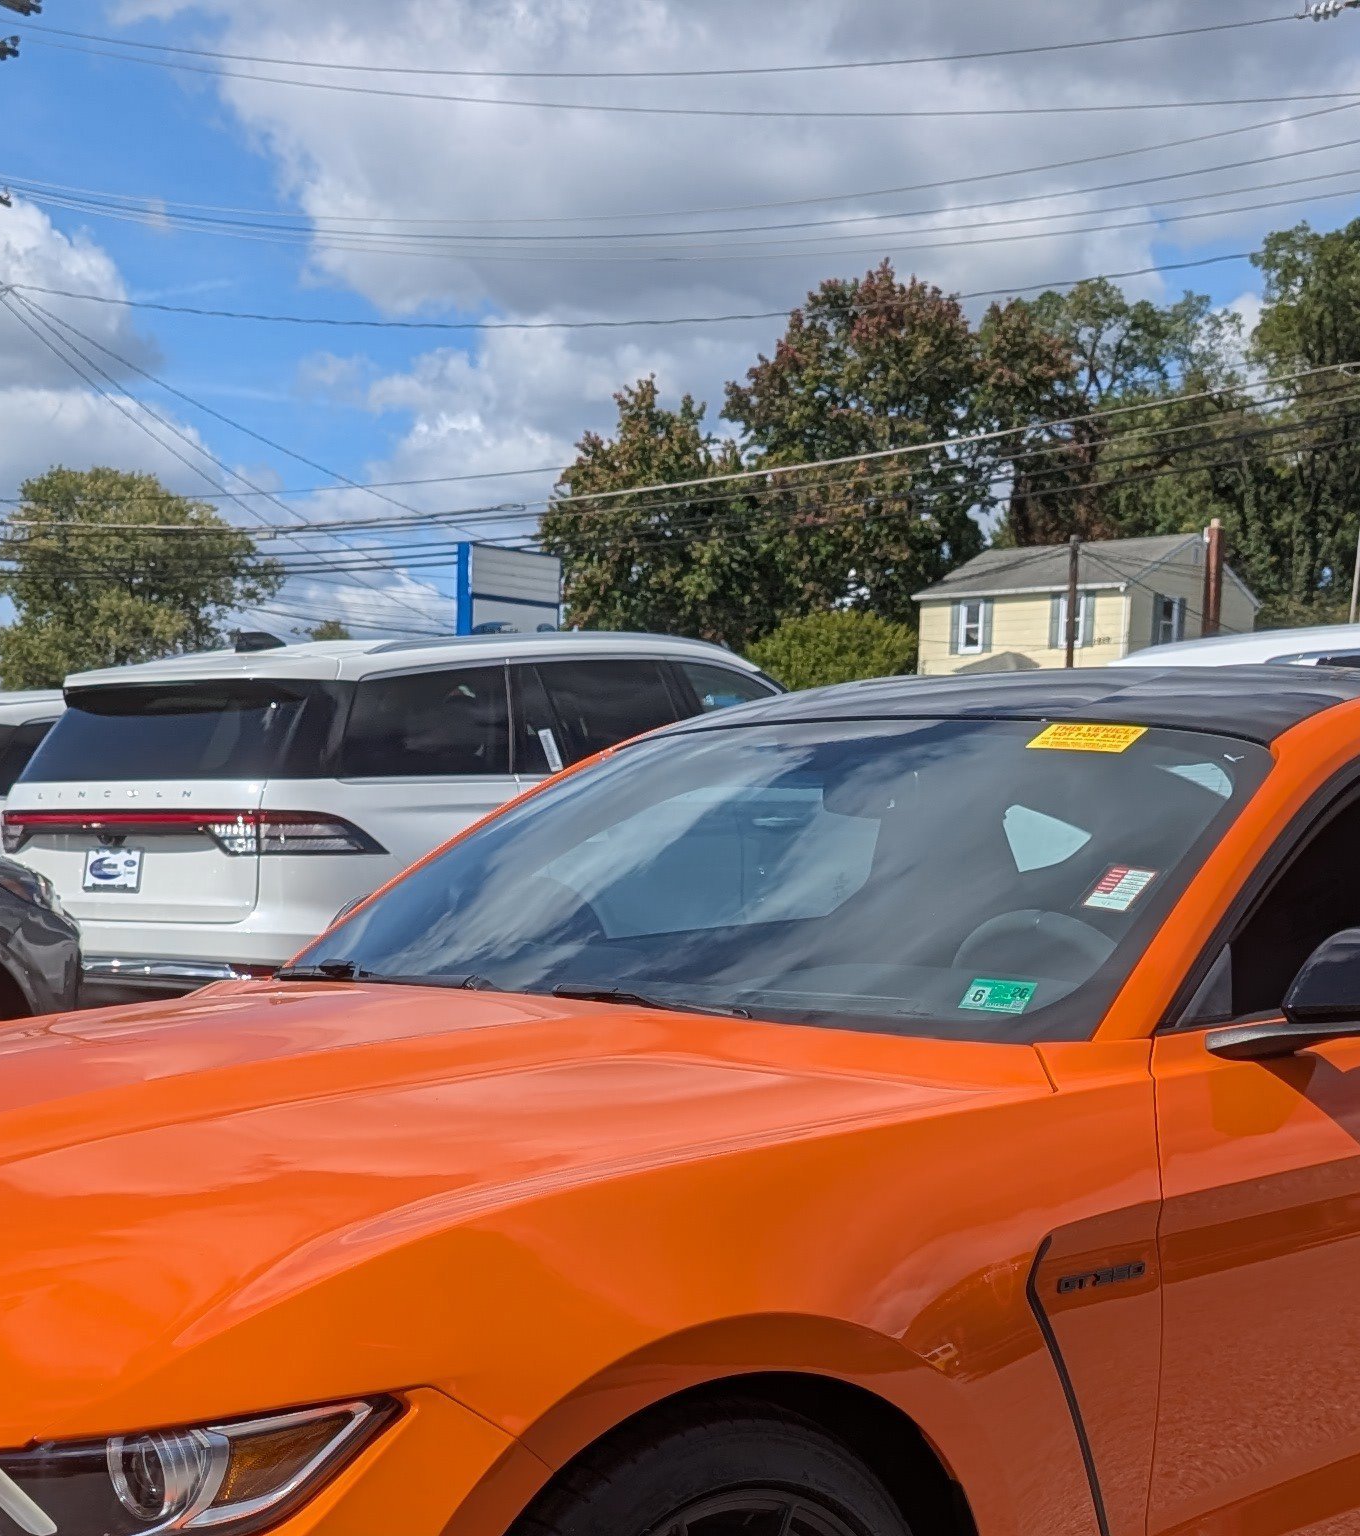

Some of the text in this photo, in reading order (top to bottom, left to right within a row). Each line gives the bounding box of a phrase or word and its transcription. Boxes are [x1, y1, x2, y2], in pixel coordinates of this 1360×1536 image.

[1087, 727, 1142, 735] VEHICLE
[38, 790, 191, 800] LINCOLN
[972, 989, 985, 1002] 6
[1011, 987, 1030, 999] 26
